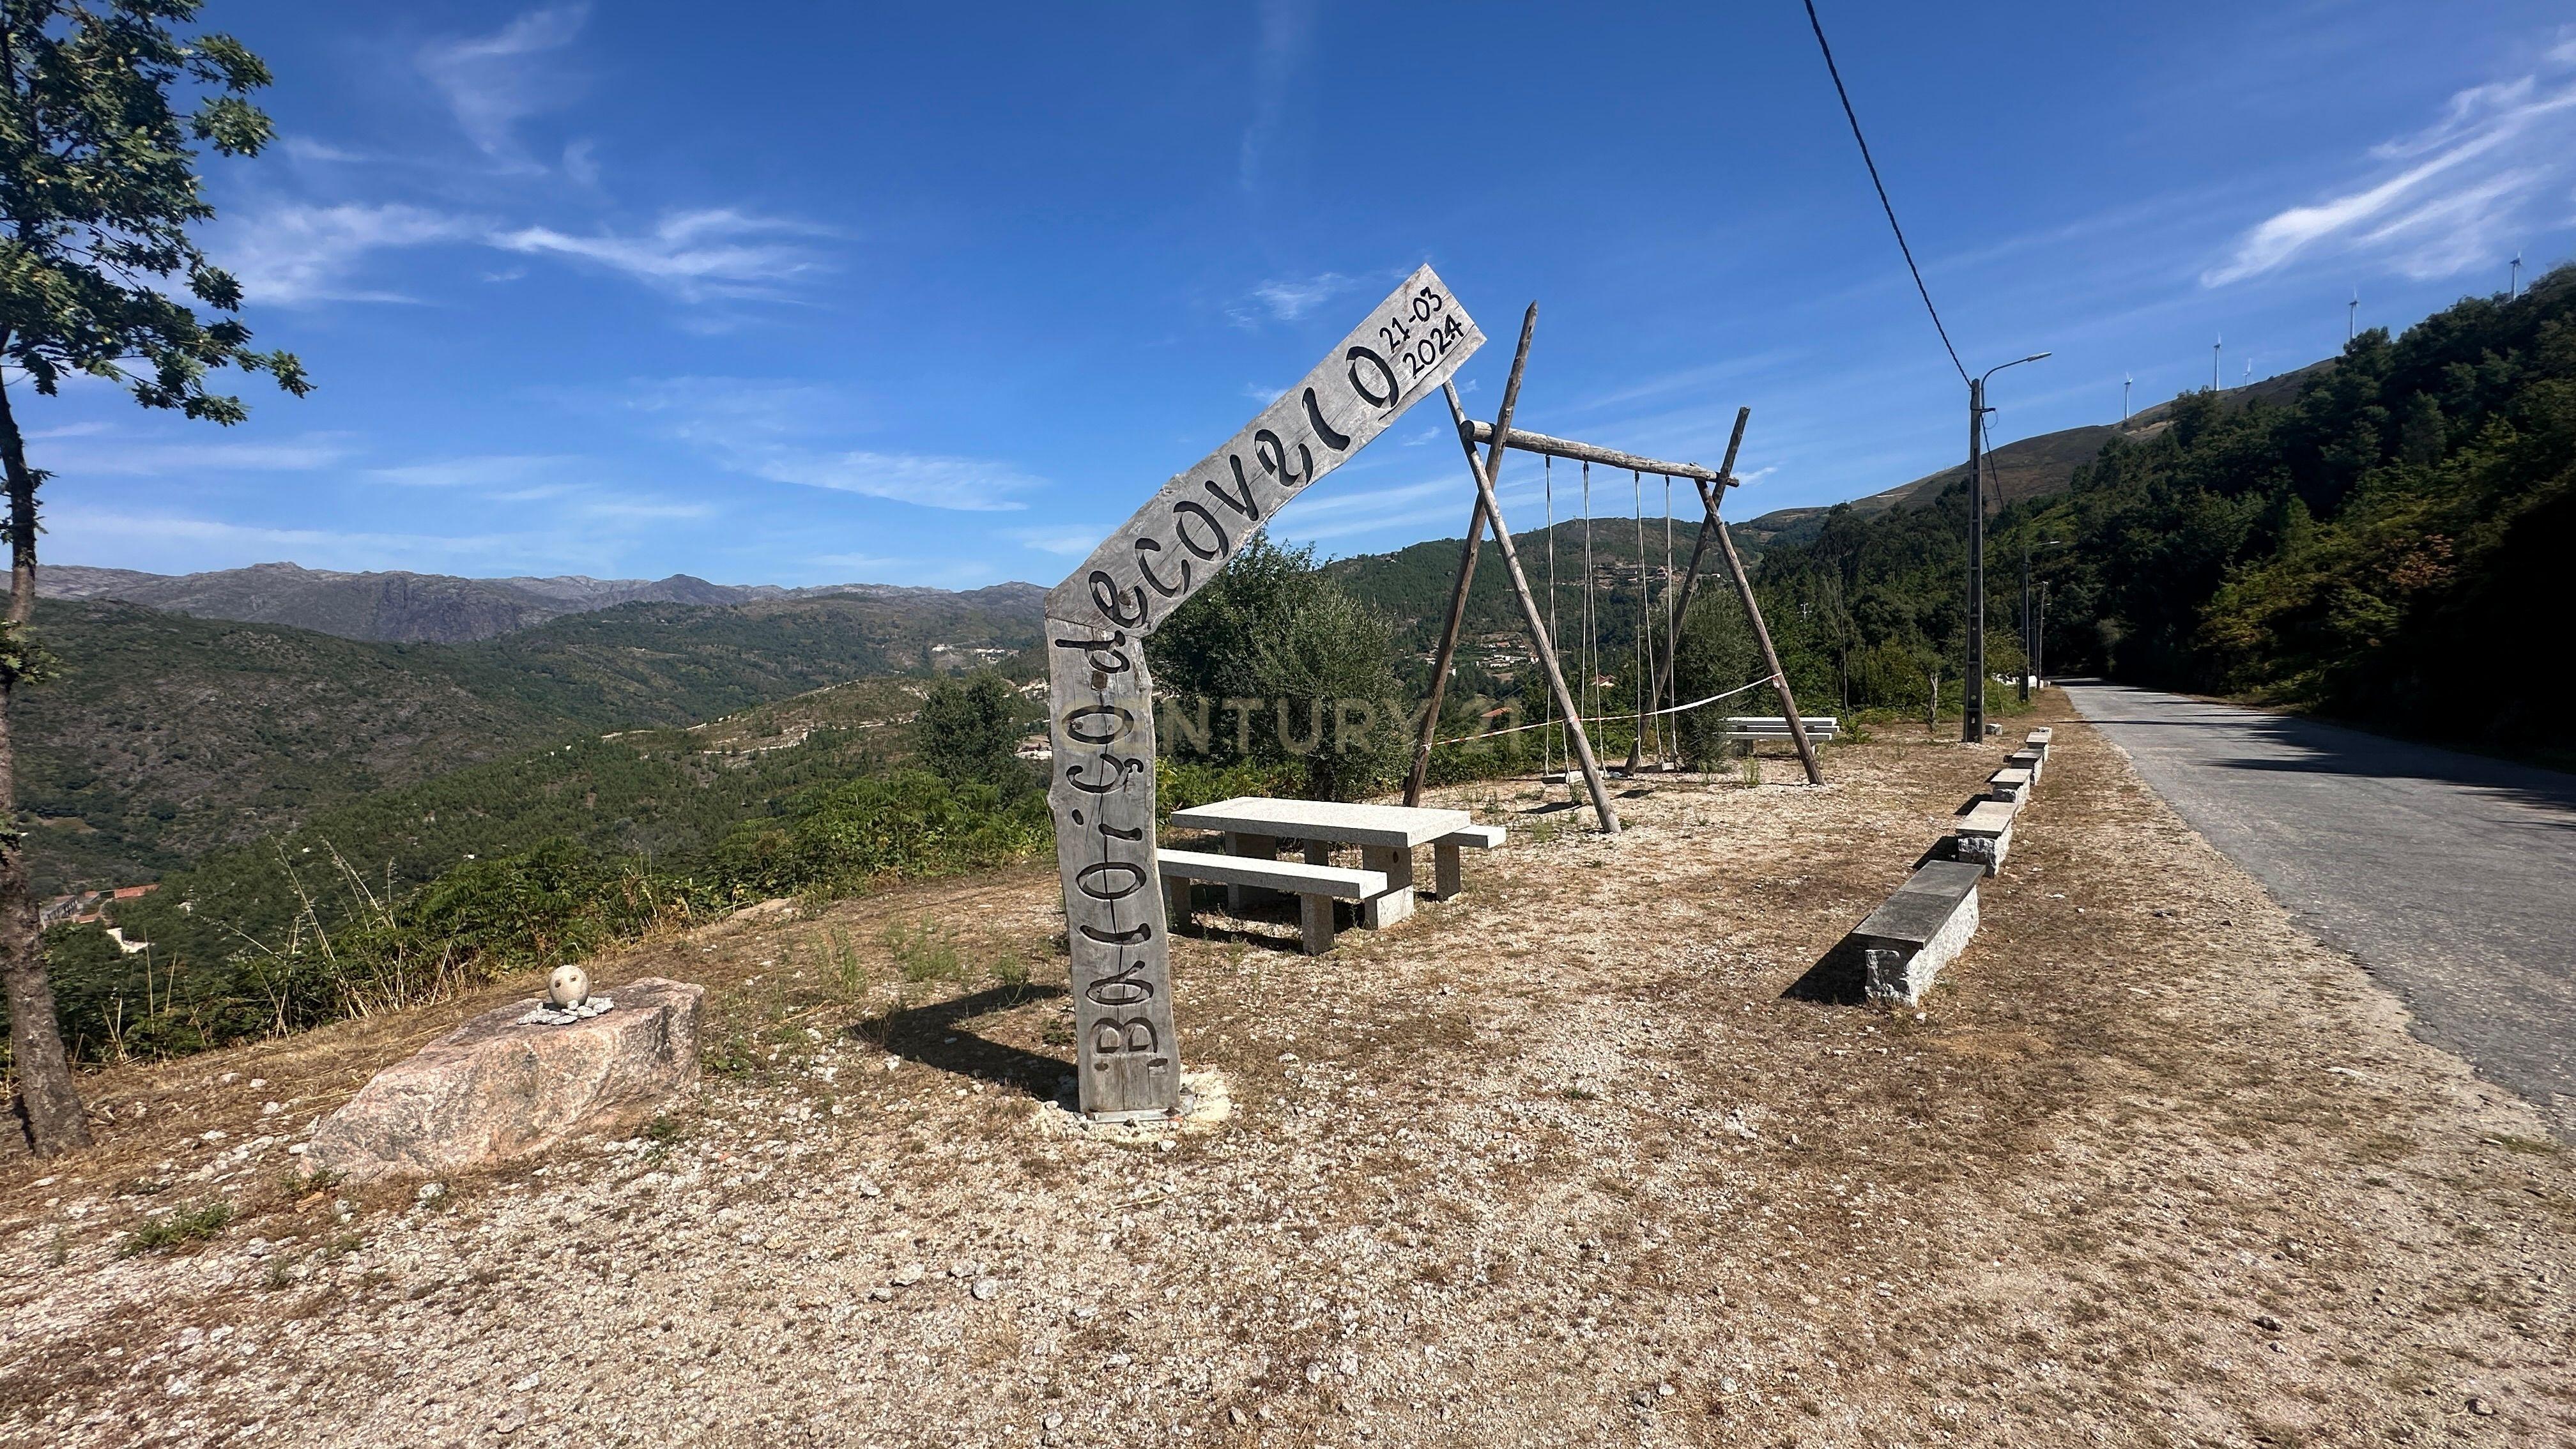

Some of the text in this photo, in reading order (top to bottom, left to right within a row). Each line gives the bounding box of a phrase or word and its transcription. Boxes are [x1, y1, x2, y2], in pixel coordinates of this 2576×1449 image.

[1379, 286, 1442, 353] 21-03
[1402, 314, 1464, 379] 2024
[1055, 570, 1148, 674] de
